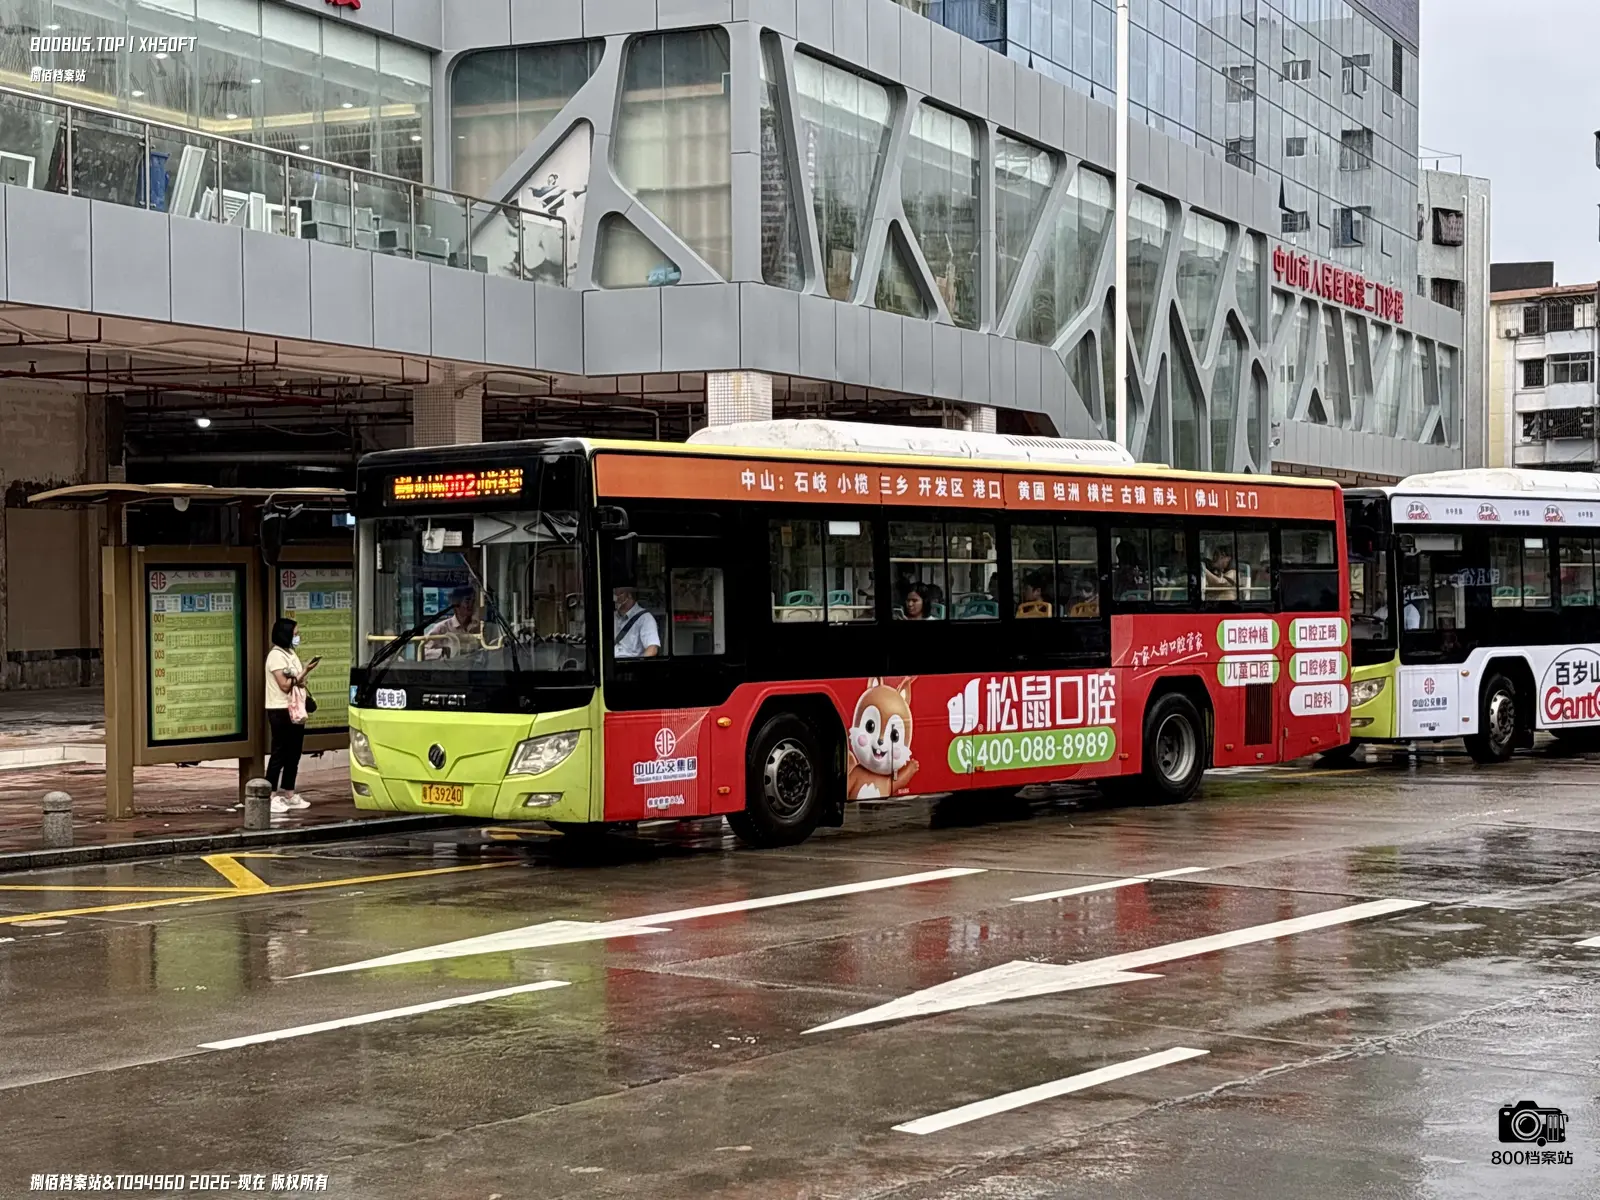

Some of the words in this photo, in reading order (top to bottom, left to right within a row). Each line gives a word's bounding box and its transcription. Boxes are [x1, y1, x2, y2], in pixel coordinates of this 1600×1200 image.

[794, 471, 828, 493] 石岐
[879, 475, 909, 496] 三乡
[918, 476, 964, 498] 开发区
[972, 478, 1001, 499] 港口
[1053, 482, 1080, 503] 坦洲
[1087, 482, 1114, 503] 横栏
[1120, 485, 1146, 505] 古镇
[1153, 487, 1178, 506] 南头
[1195, 489, 1219, 508] 佛山
[1235, 491, 1259, 509] 江门
[153, 613, 165, 623] 001
[153, 632, 165, 642] 002
[1227, 626, 1269, 644] 口腔种植
[1227, 661, 1270, 680] 儿童口腔
[1299, 658, 1338, 676] 口腔修复
[1555, 660, 1600, 686] 百岁山
[377, 691, 405, 706] 纯电动
[986, 671, 1117, 732] 松鼠口腔
[1304, 691, 1333, 709] 口腔科
[976, 731, 1109, 765] 400-088-8989
